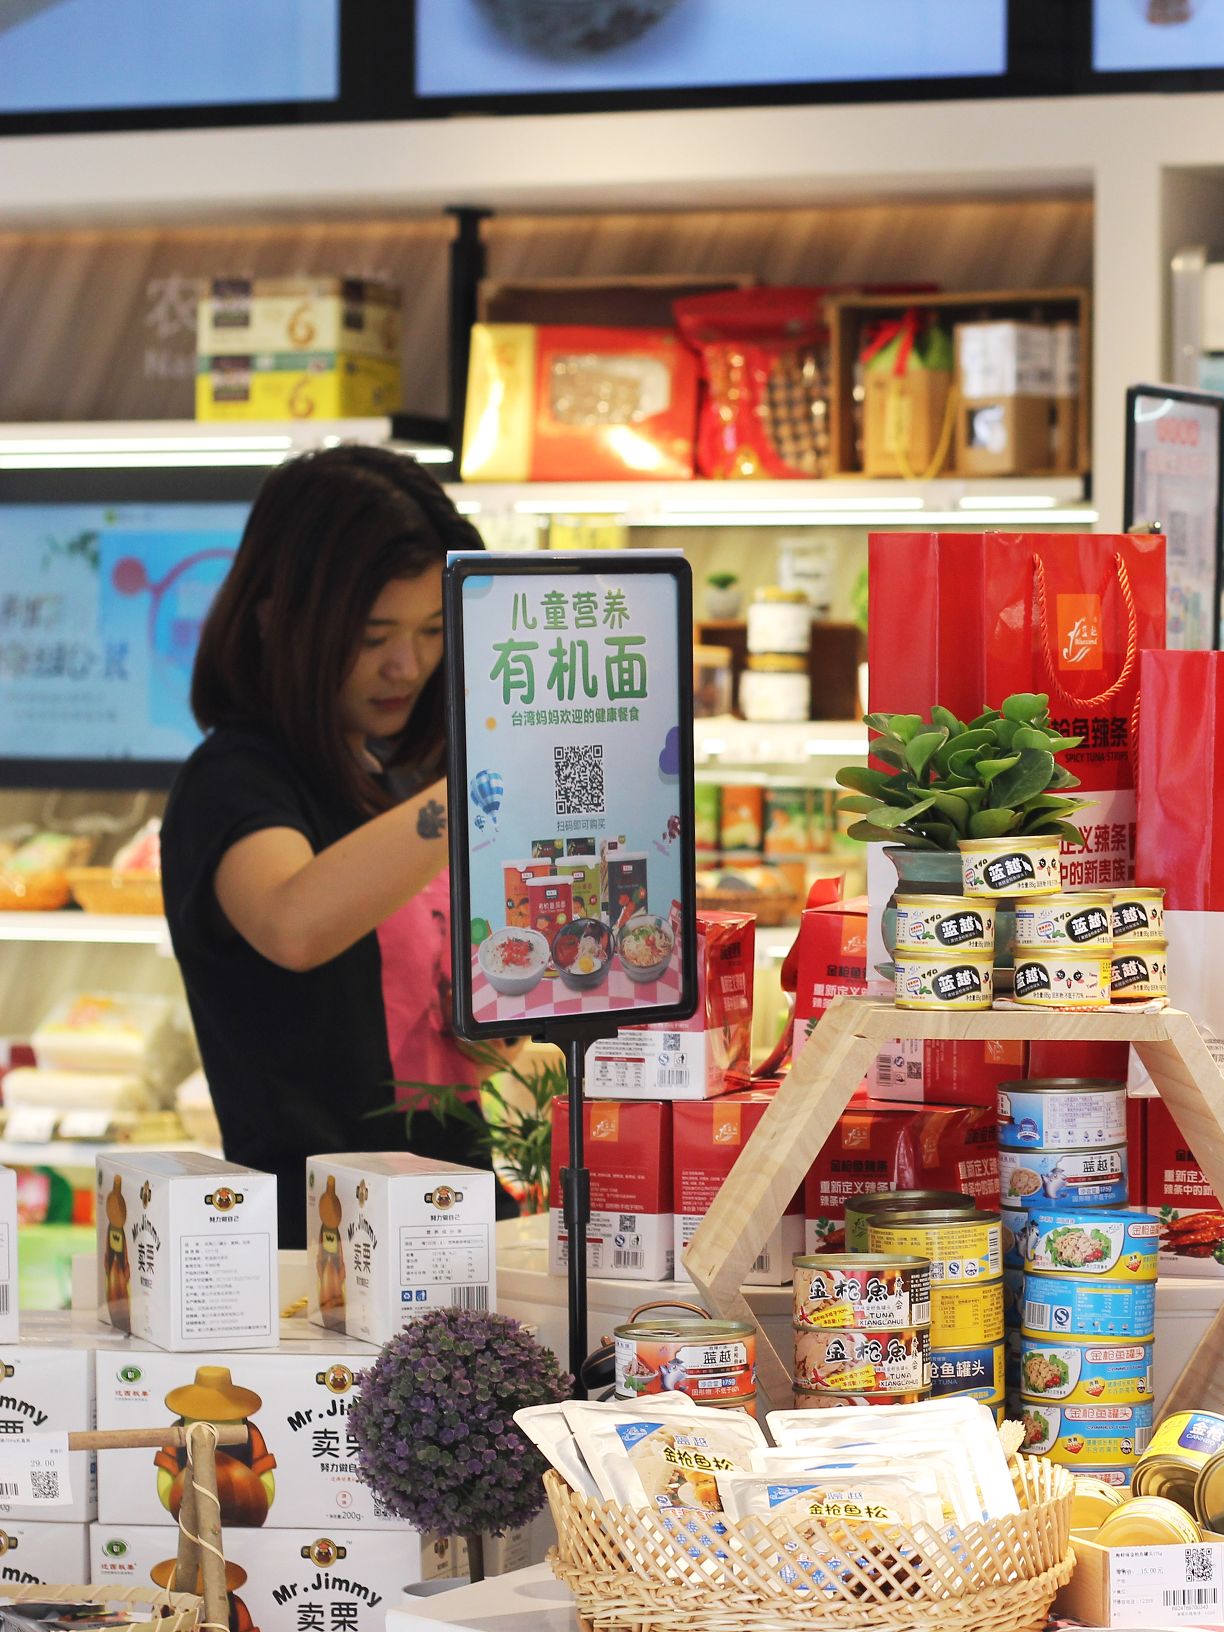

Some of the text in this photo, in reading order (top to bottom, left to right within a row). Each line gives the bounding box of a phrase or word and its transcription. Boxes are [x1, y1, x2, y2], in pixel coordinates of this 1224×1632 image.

[511, 588, 631, 631] 儿童营养
[489, 635, 648, 705] 有机面
[511, 706, 640, 727] 台湾妈妈欢迎的健康餐食
[1065, 751, 1128, 764] SPICY TUNA STRIPS
[556, 817, 606, 833] 扫码即可购买
[988, 857, 1023, 883] 蓝越
[941, 915, 975, 938] 蓝越
[1071, 912, 1103, 936] 蓝越
[938, 970, 972, 993] 蓝越
[1016, 966, 1038, 990] 蓝越
[1164, 1184, 1216, 1196] 辣条中的新
[704, 1350, 731, 1365] 蓝越
[1090, 1348, 1143, 1360] 金枪鱼罐头
[1069, 1408, 1130, 1419] 金枪鱼罐头
[663, 1447, 734, 1472] 金枪鱼松
[342, 1510, 361, 1521] 200g
[809, 1504, 888, 1519] 金枪鱼松
[272, 1573, 383, 1608] Mr.Jimmy
[297, 1602, 359, 1632] 卖栗
